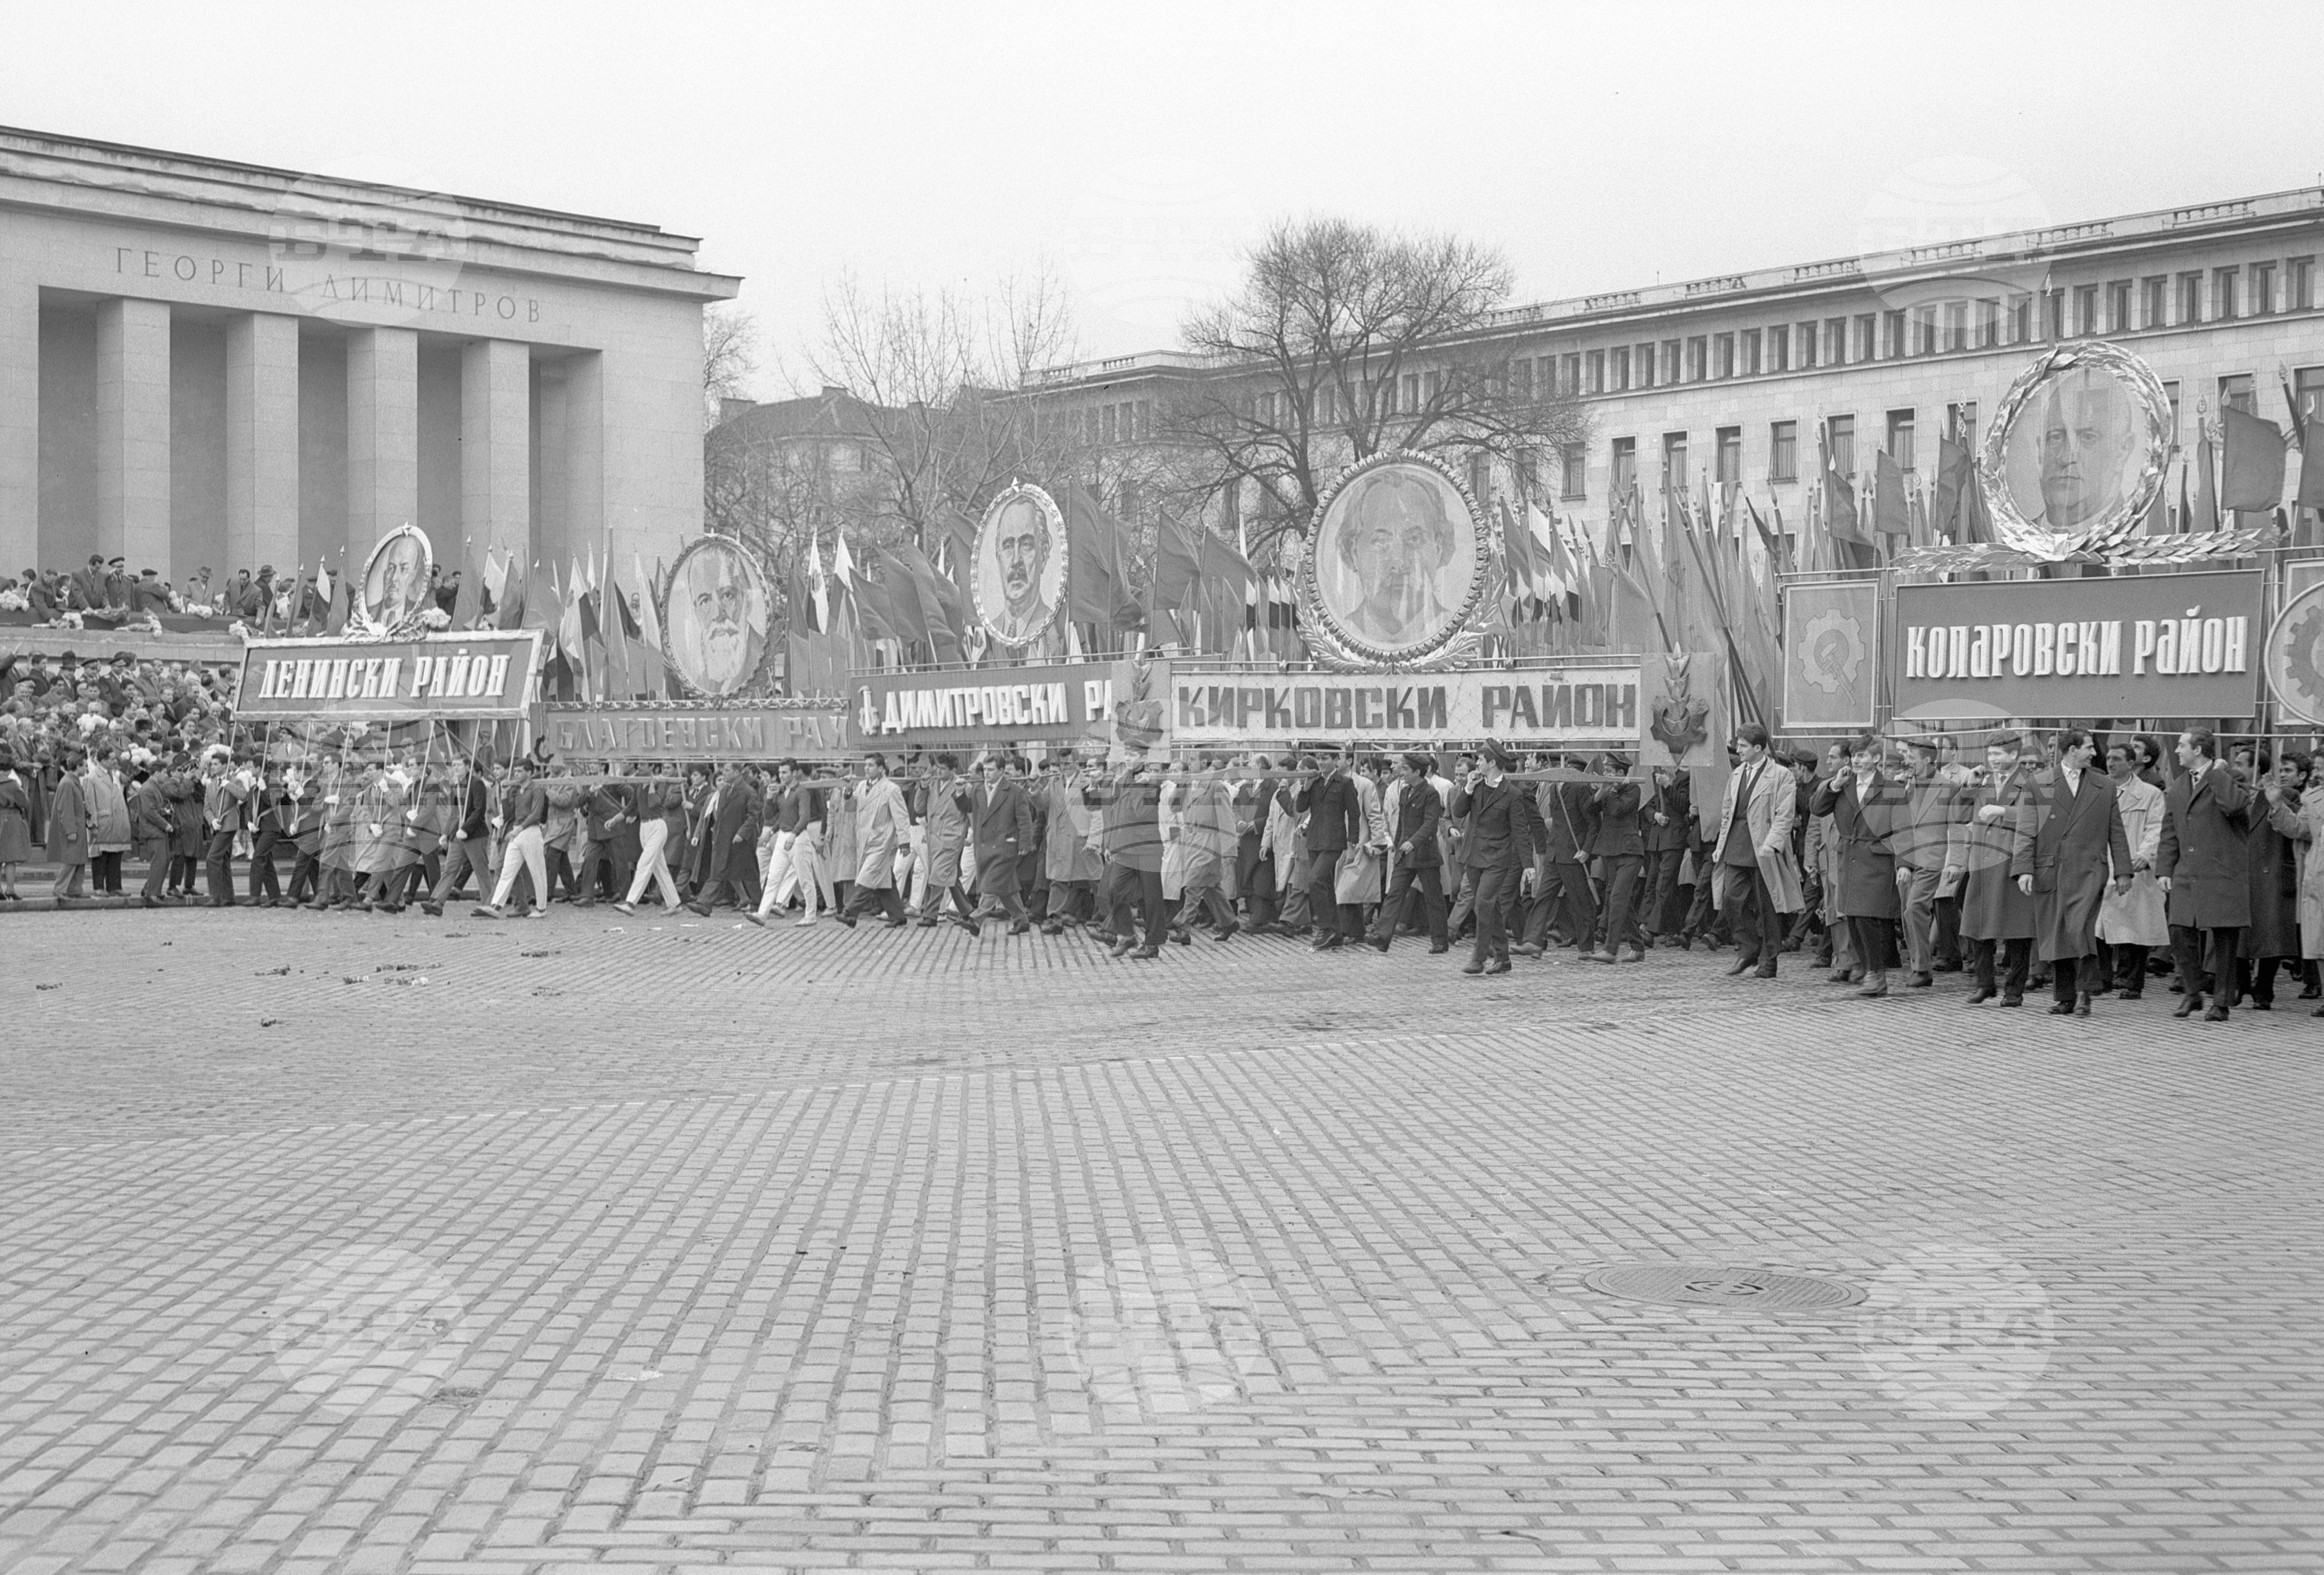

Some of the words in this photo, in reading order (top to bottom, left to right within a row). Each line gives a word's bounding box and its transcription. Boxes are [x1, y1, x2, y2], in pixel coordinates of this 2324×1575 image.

[116, 247, 284, 292] ГЕОРГИ
[320, 274, 540, 322] ДИМИТРОВ
[259, 657, 402, 699] ЛЕНИНСКИ
[410, 648, 510, 698] РАЙОН
[881, 682, 1068, 734] ДИМИТРОВСКИ
[1178, 684, 1447, 730] КИРКОВСКИ
[1482, 672, 1636, 729] РАЙОН
[556, 717, 763, 749] БЛАГОЕВСКИ
